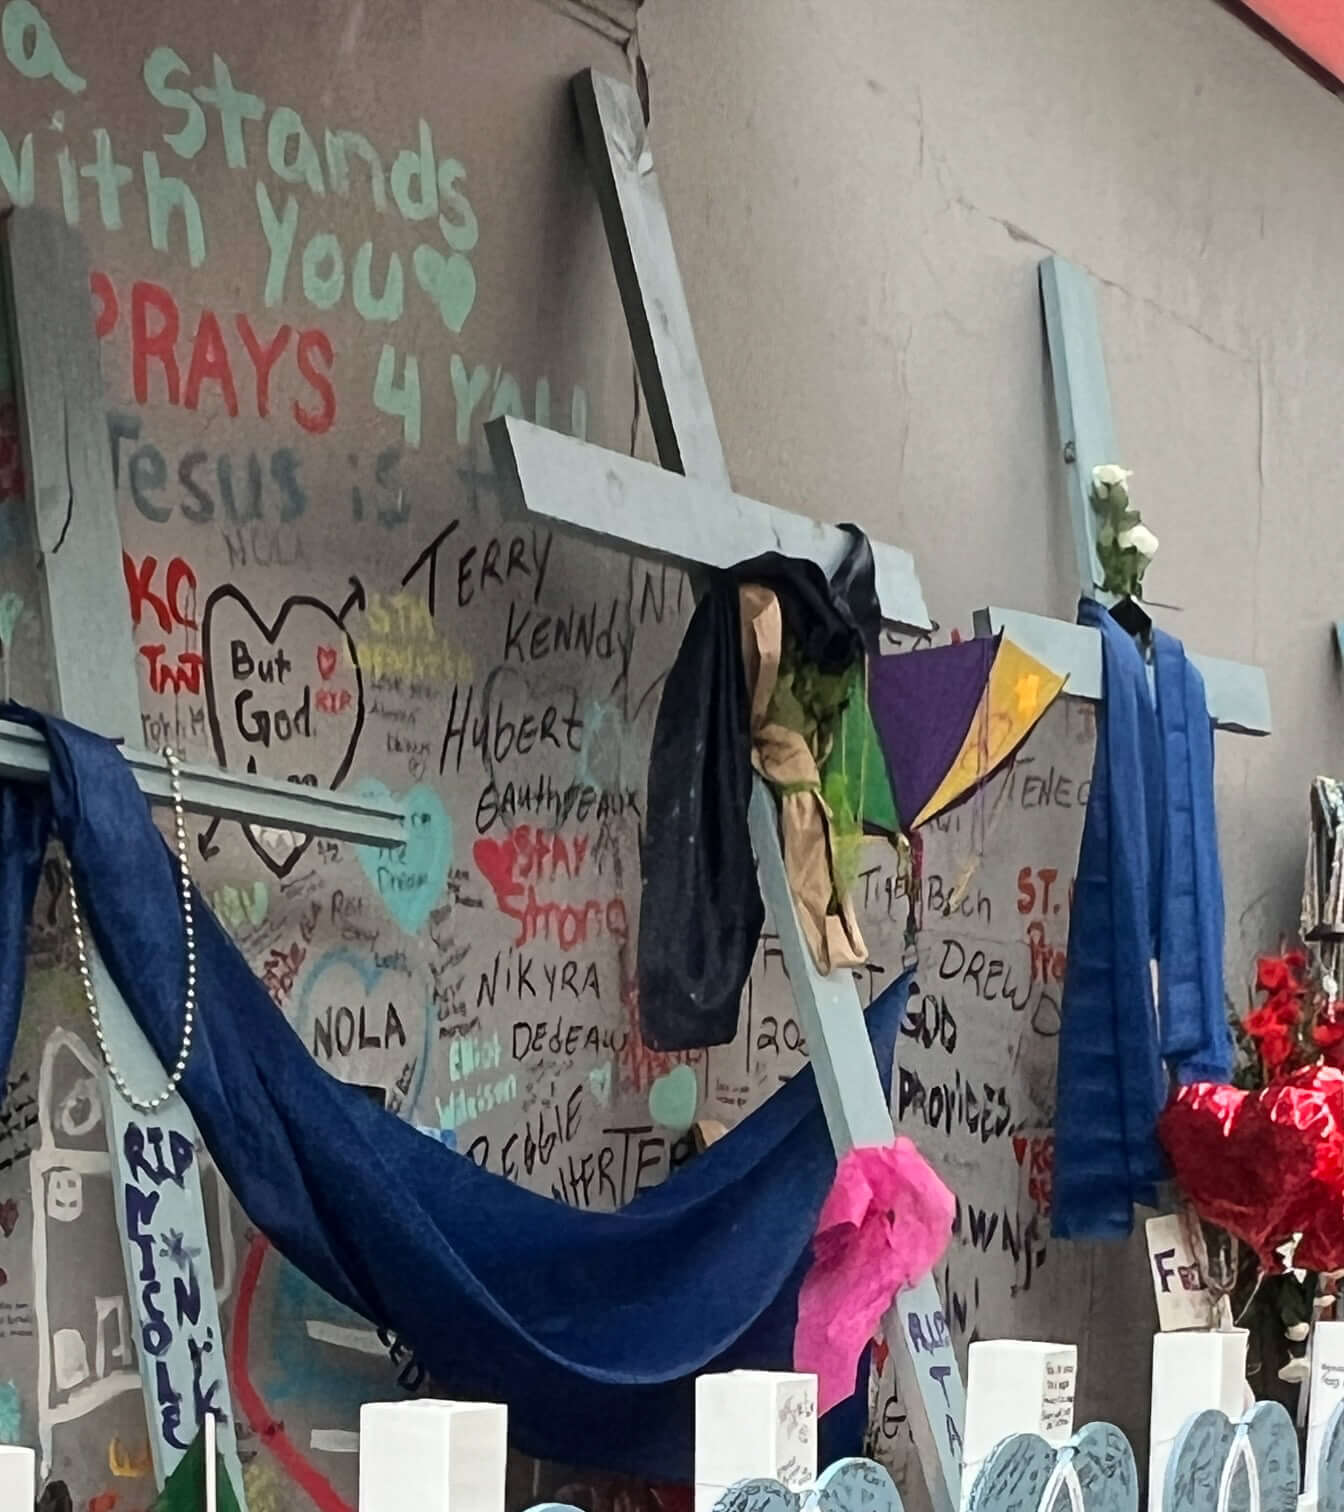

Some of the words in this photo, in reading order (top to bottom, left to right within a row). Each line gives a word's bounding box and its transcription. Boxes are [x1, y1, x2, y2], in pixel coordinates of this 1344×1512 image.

[229, 638, 293, 685] But
[311, 1001, 407, 1058] NOLA
[122, 1121, 195, 1190] RIP
